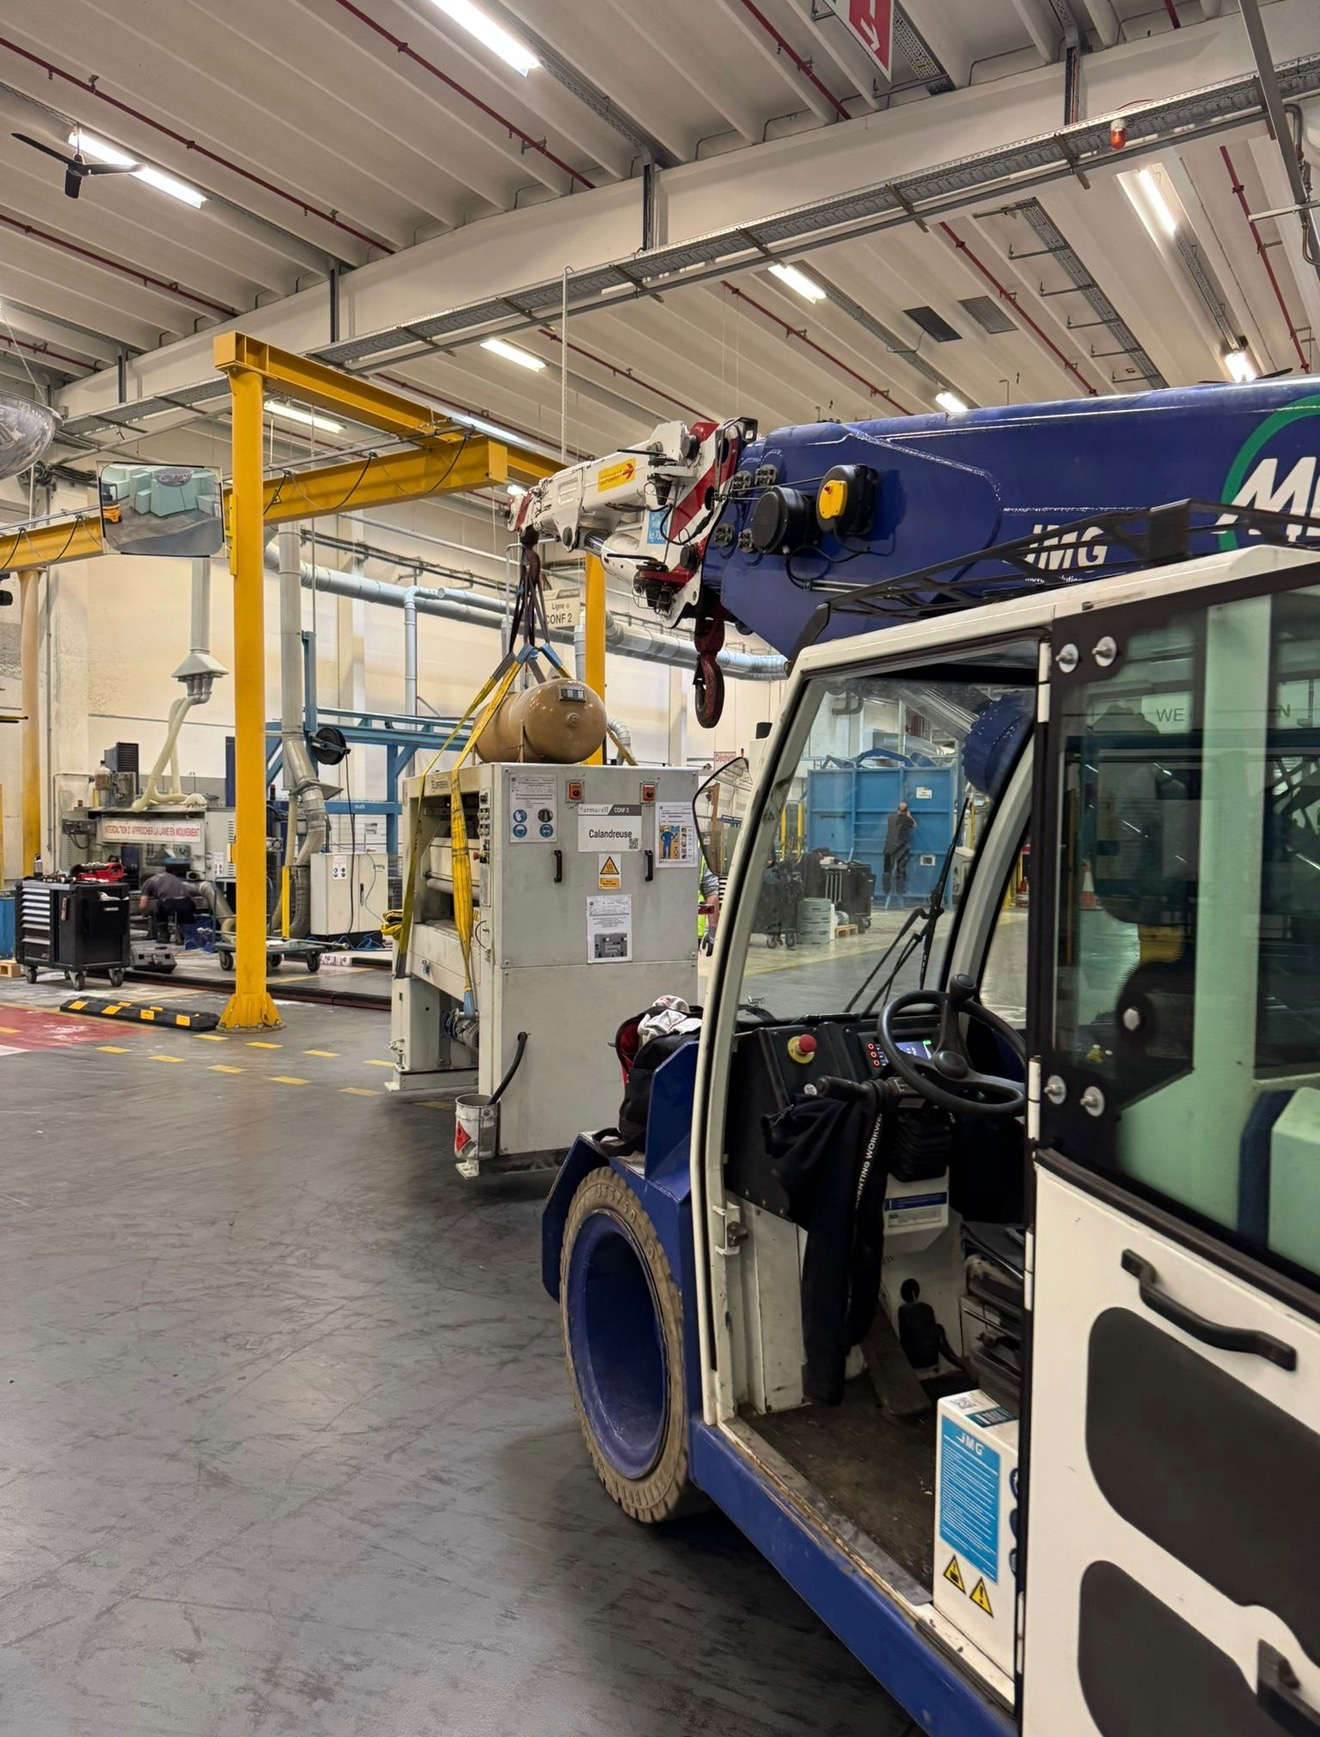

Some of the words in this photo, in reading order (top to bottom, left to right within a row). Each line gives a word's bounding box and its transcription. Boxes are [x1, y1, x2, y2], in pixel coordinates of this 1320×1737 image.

[1023, 524, 1108, 570] JMG
[567, 612, 573, 623] 2
[588, 829, 632, 839] Calandreuse
[955, 1433, 985, 1457] JMG
